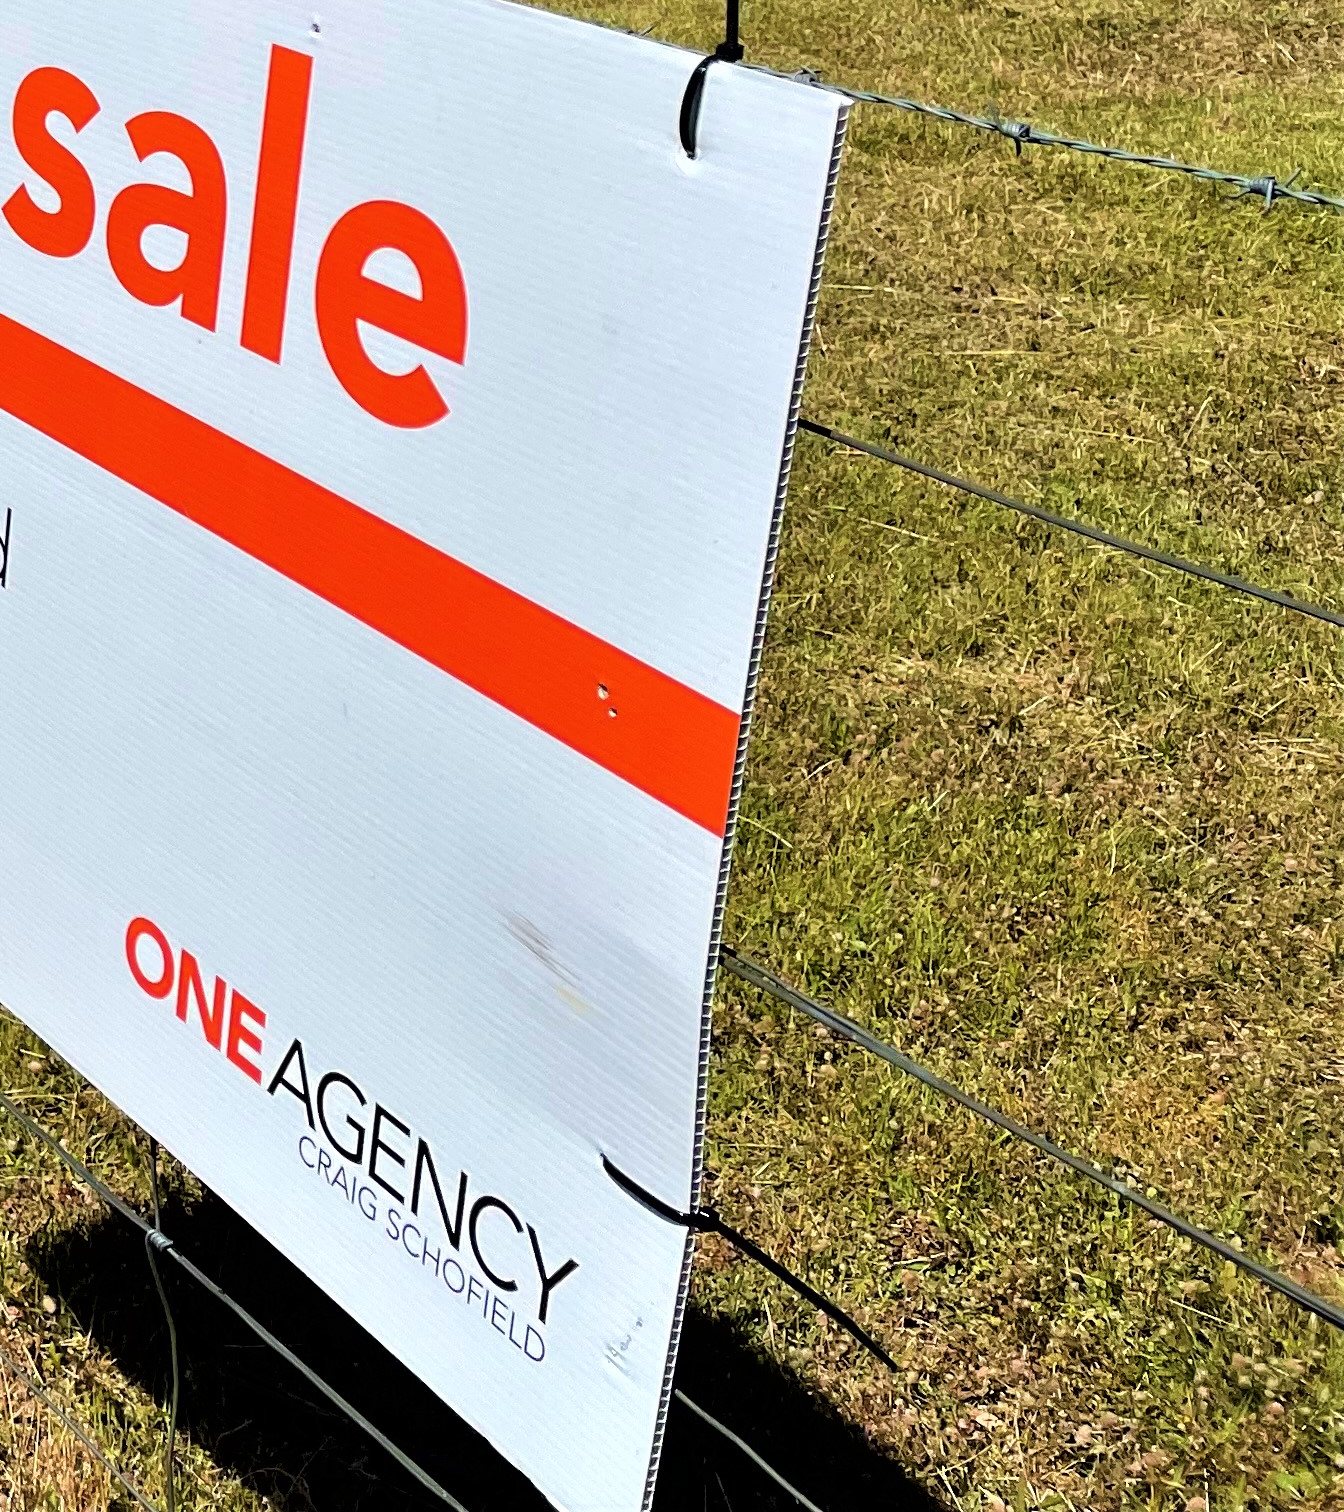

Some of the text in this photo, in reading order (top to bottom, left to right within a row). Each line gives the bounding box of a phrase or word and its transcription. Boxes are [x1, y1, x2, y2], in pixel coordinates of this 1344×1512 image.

[2, 43, 469, 428] sale
[298, 1135, 546, 1363] CRAIG SCHOFIELD
